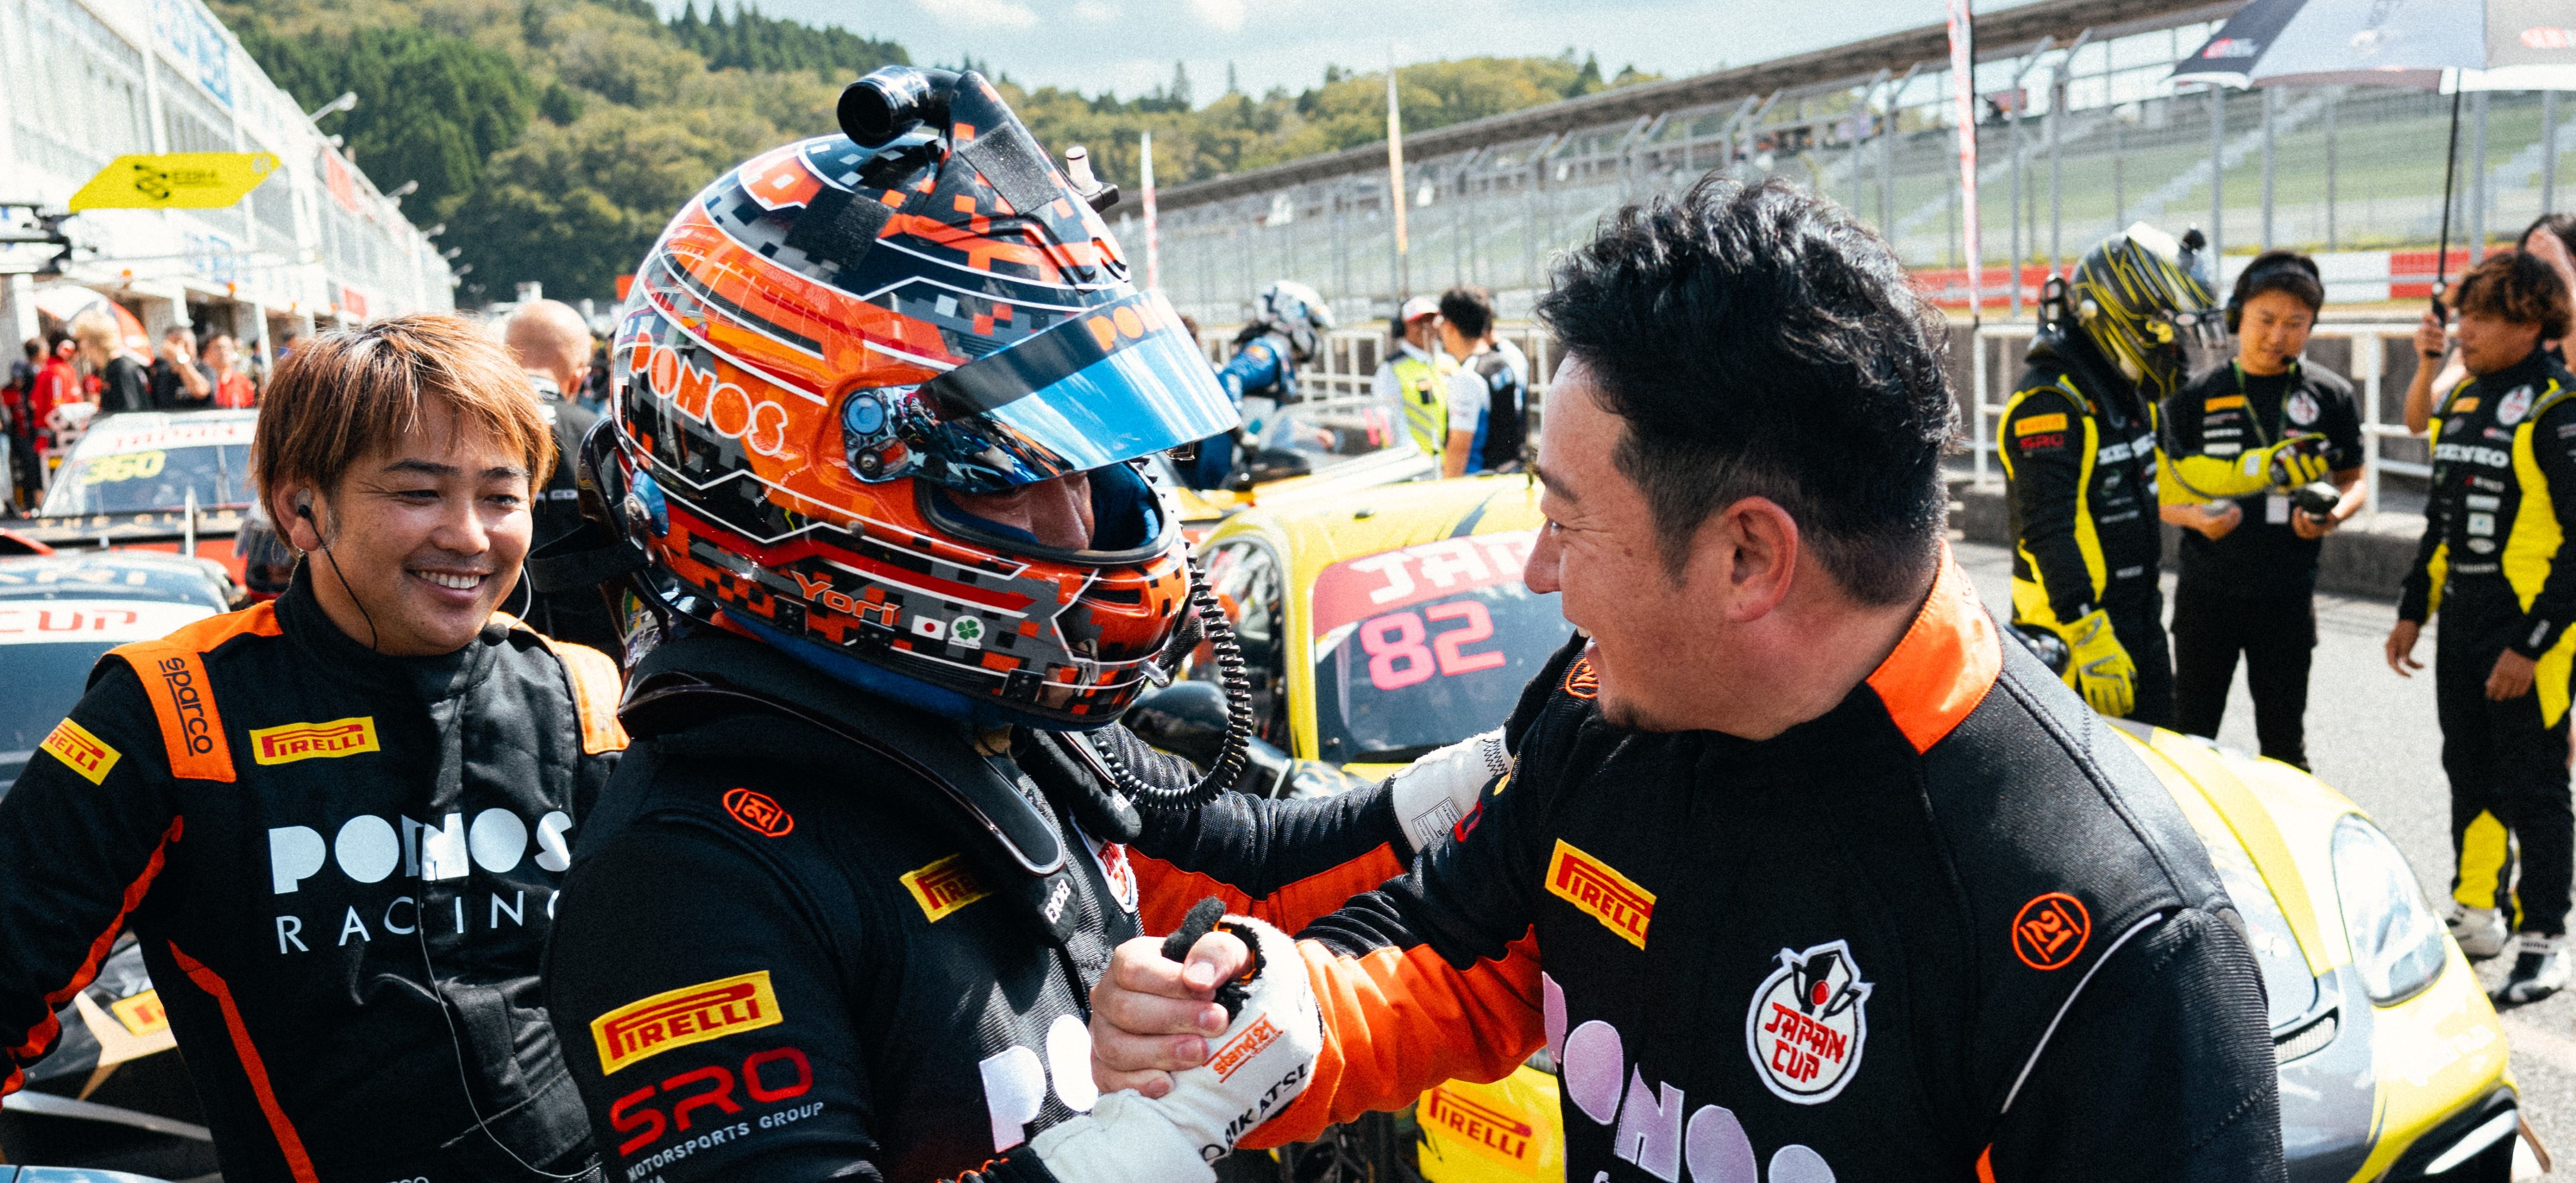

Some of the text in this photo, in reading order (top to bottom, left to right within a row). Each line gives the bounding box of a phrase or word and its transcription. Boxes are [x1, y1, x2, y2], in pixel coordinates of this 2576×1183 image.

[630, 332, 788, 456] PONOS
[84, 449, 166, 486] 360
[791, 570, 901, 627] Yori
[1349, 529, 1543, 604] JAP
[1360, 600, 1506, 691] 82
[159, 657, 213, 756] sparco
[261, 724, 365, 757] PIRELLI
[48, 723, 105, 772] RELLI
[268, 807, 572, 894] PONOS
[1445, 812, 1455, 826] Standa
[1447, 806, 1459, 822] complia
[604, 983, 761, 1060] PIRELLI
[1765, 1002, 1848, 1064] JAPAN
[1771, 1040, 1820, 1084] CUP
[610, 1046, 813, 1157] SRO
[1428, 1087, 1534, 1160] PIRELLI
[626, 1102, 824, 1183] MOTORSPORTS GROUP
